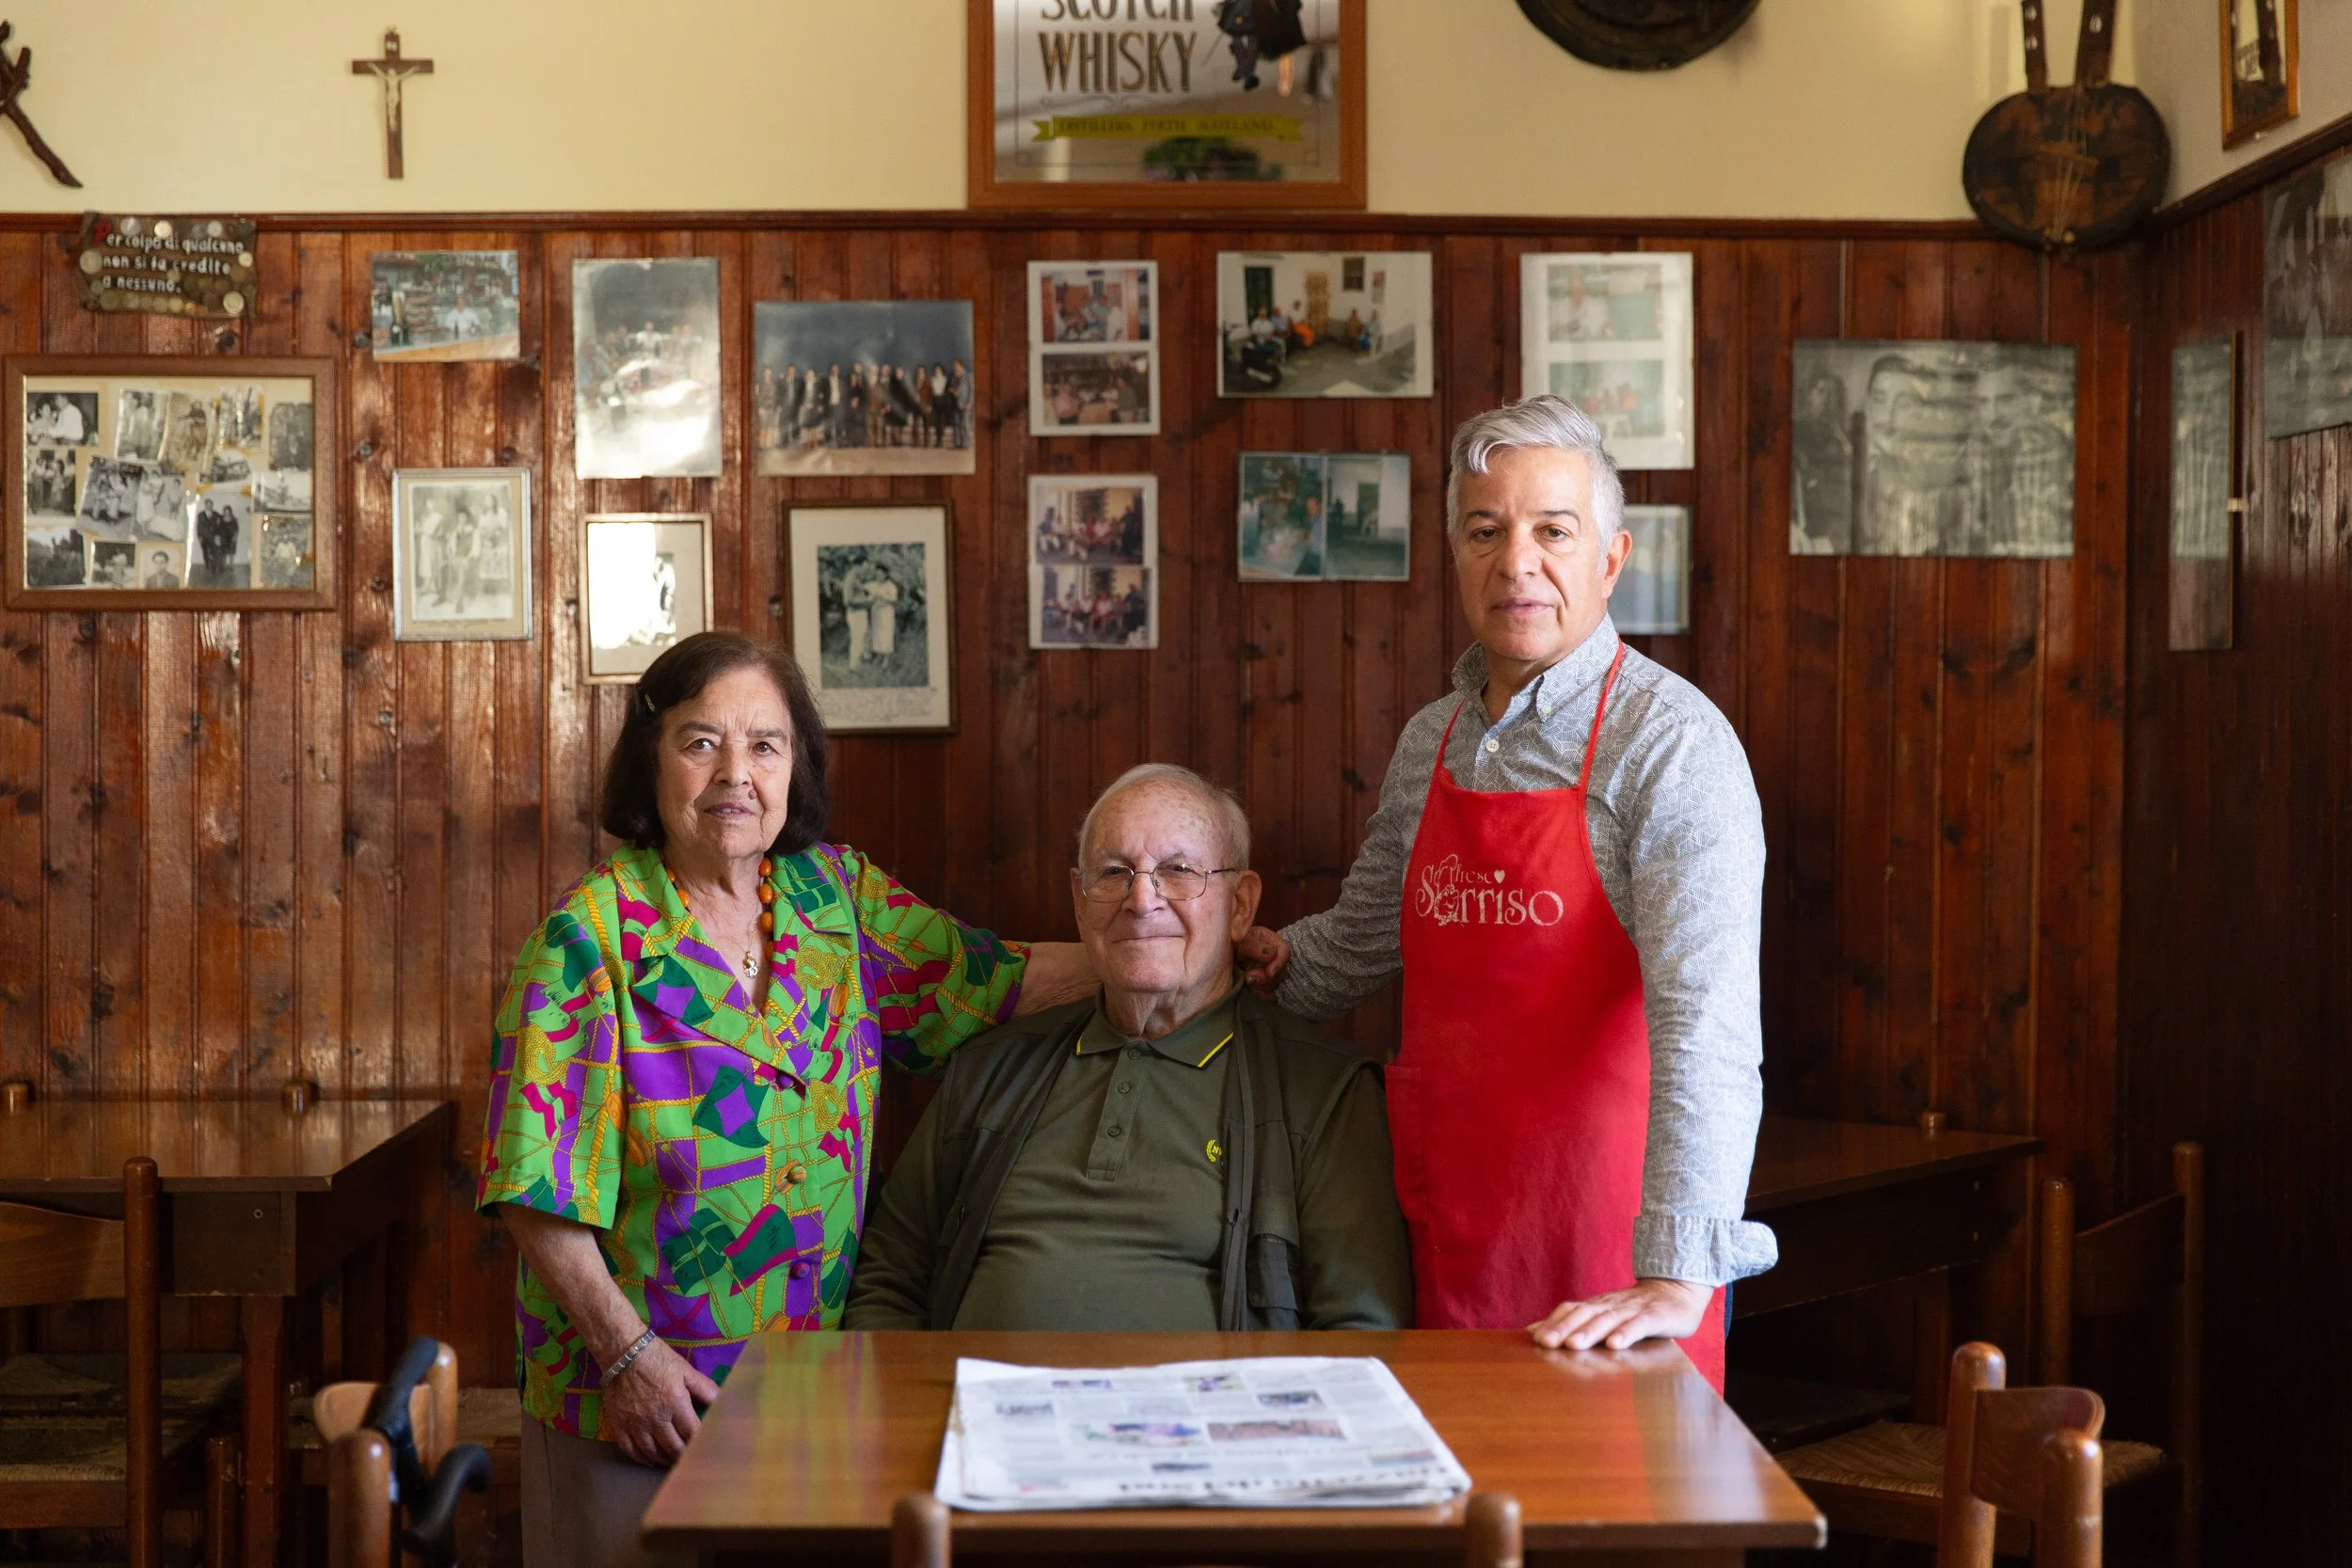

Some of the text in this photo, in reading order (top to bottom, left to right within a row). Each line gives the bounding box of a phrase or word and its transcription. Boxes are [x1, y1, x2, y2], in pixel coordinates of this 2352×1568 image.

[1039, 31, 1198, 93] WHISKY
[125, 232, 161, 254] colpa
[164, 232, 179, 250] di
[182, 236, 245, 255] qualcuno
[103, 256, 130, 269] non
[135, 256, 147, 270] si
[172, 257, 231, 276] credito
[103, 275, 112, 289] a
